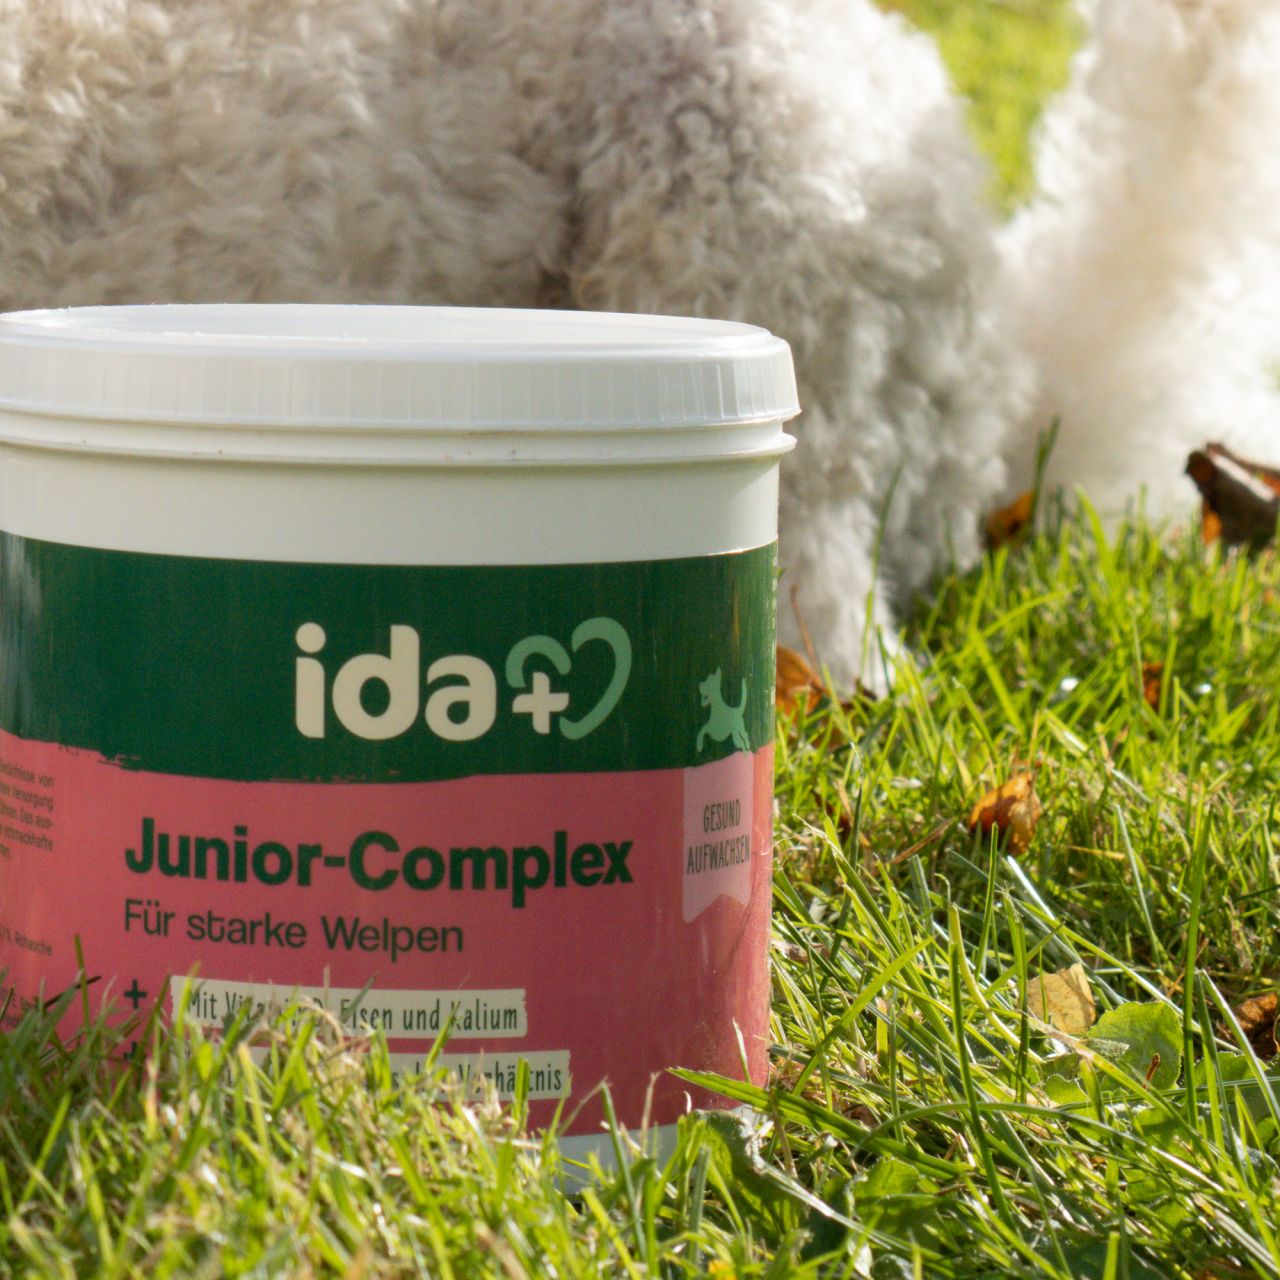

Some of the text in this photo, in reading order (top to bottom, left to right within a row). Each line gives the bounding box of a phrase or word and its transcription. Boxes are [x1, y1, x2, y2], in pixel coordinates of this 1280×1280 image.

[703, 799, 741, 833] GESUND
[124, 816, 635, 909] Junior-Complex
[686, 834, 751, 875] AUFWACHSEN
[124, 898, 465, 964] Für starke Welpen
[403, 997, 440, 1031] und
